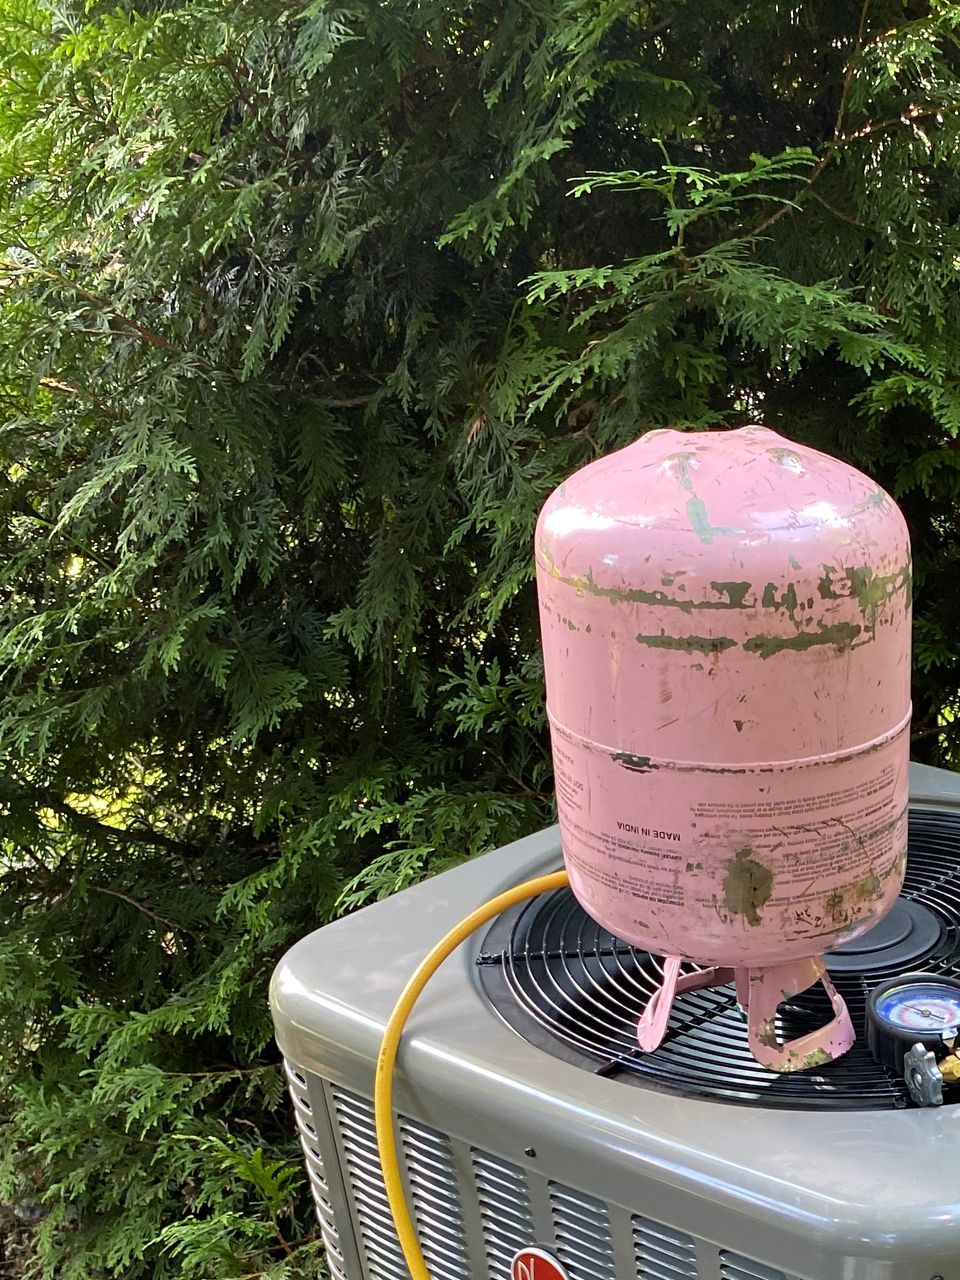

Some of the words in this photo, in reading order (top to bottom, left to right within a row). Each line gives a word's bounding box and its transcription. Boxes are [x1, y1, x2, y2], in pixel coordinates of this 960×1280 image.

[617, 821, 639, 834] INDIA
[642, 827, 650, 836] IN
[653, 830, 680, 841] MADE
